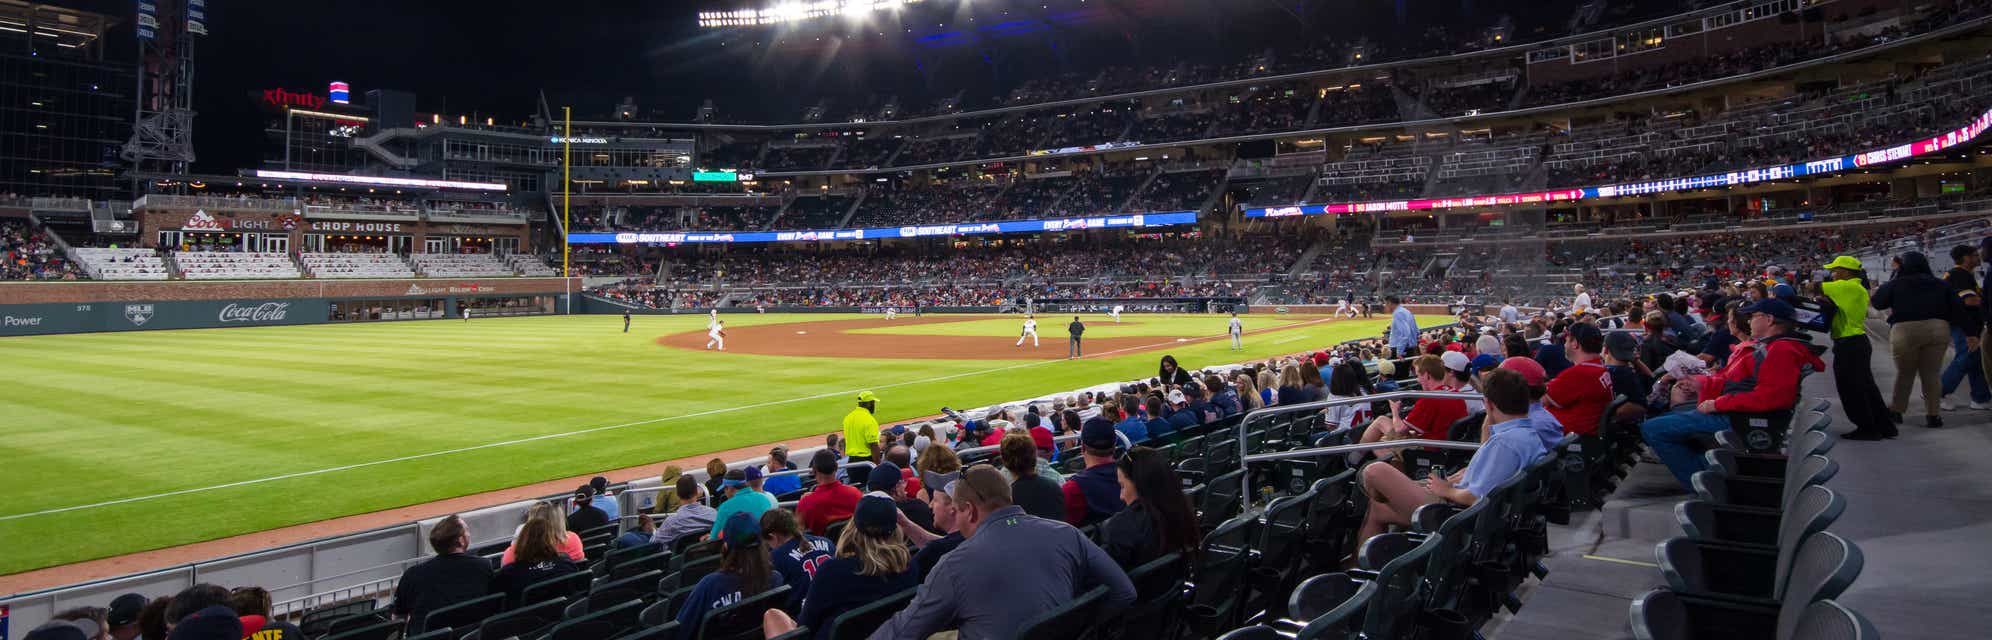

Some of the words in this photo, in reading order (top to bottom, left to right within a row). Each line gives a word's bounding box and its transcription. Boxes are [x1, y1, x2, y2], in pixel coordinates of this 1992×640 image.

[232, 219, 270, 229] LIGHT
[312, 222, 350, 231] CHOP
[356, 223, 400, 232] HOUSE
[4, 315, 42, 327] Power
